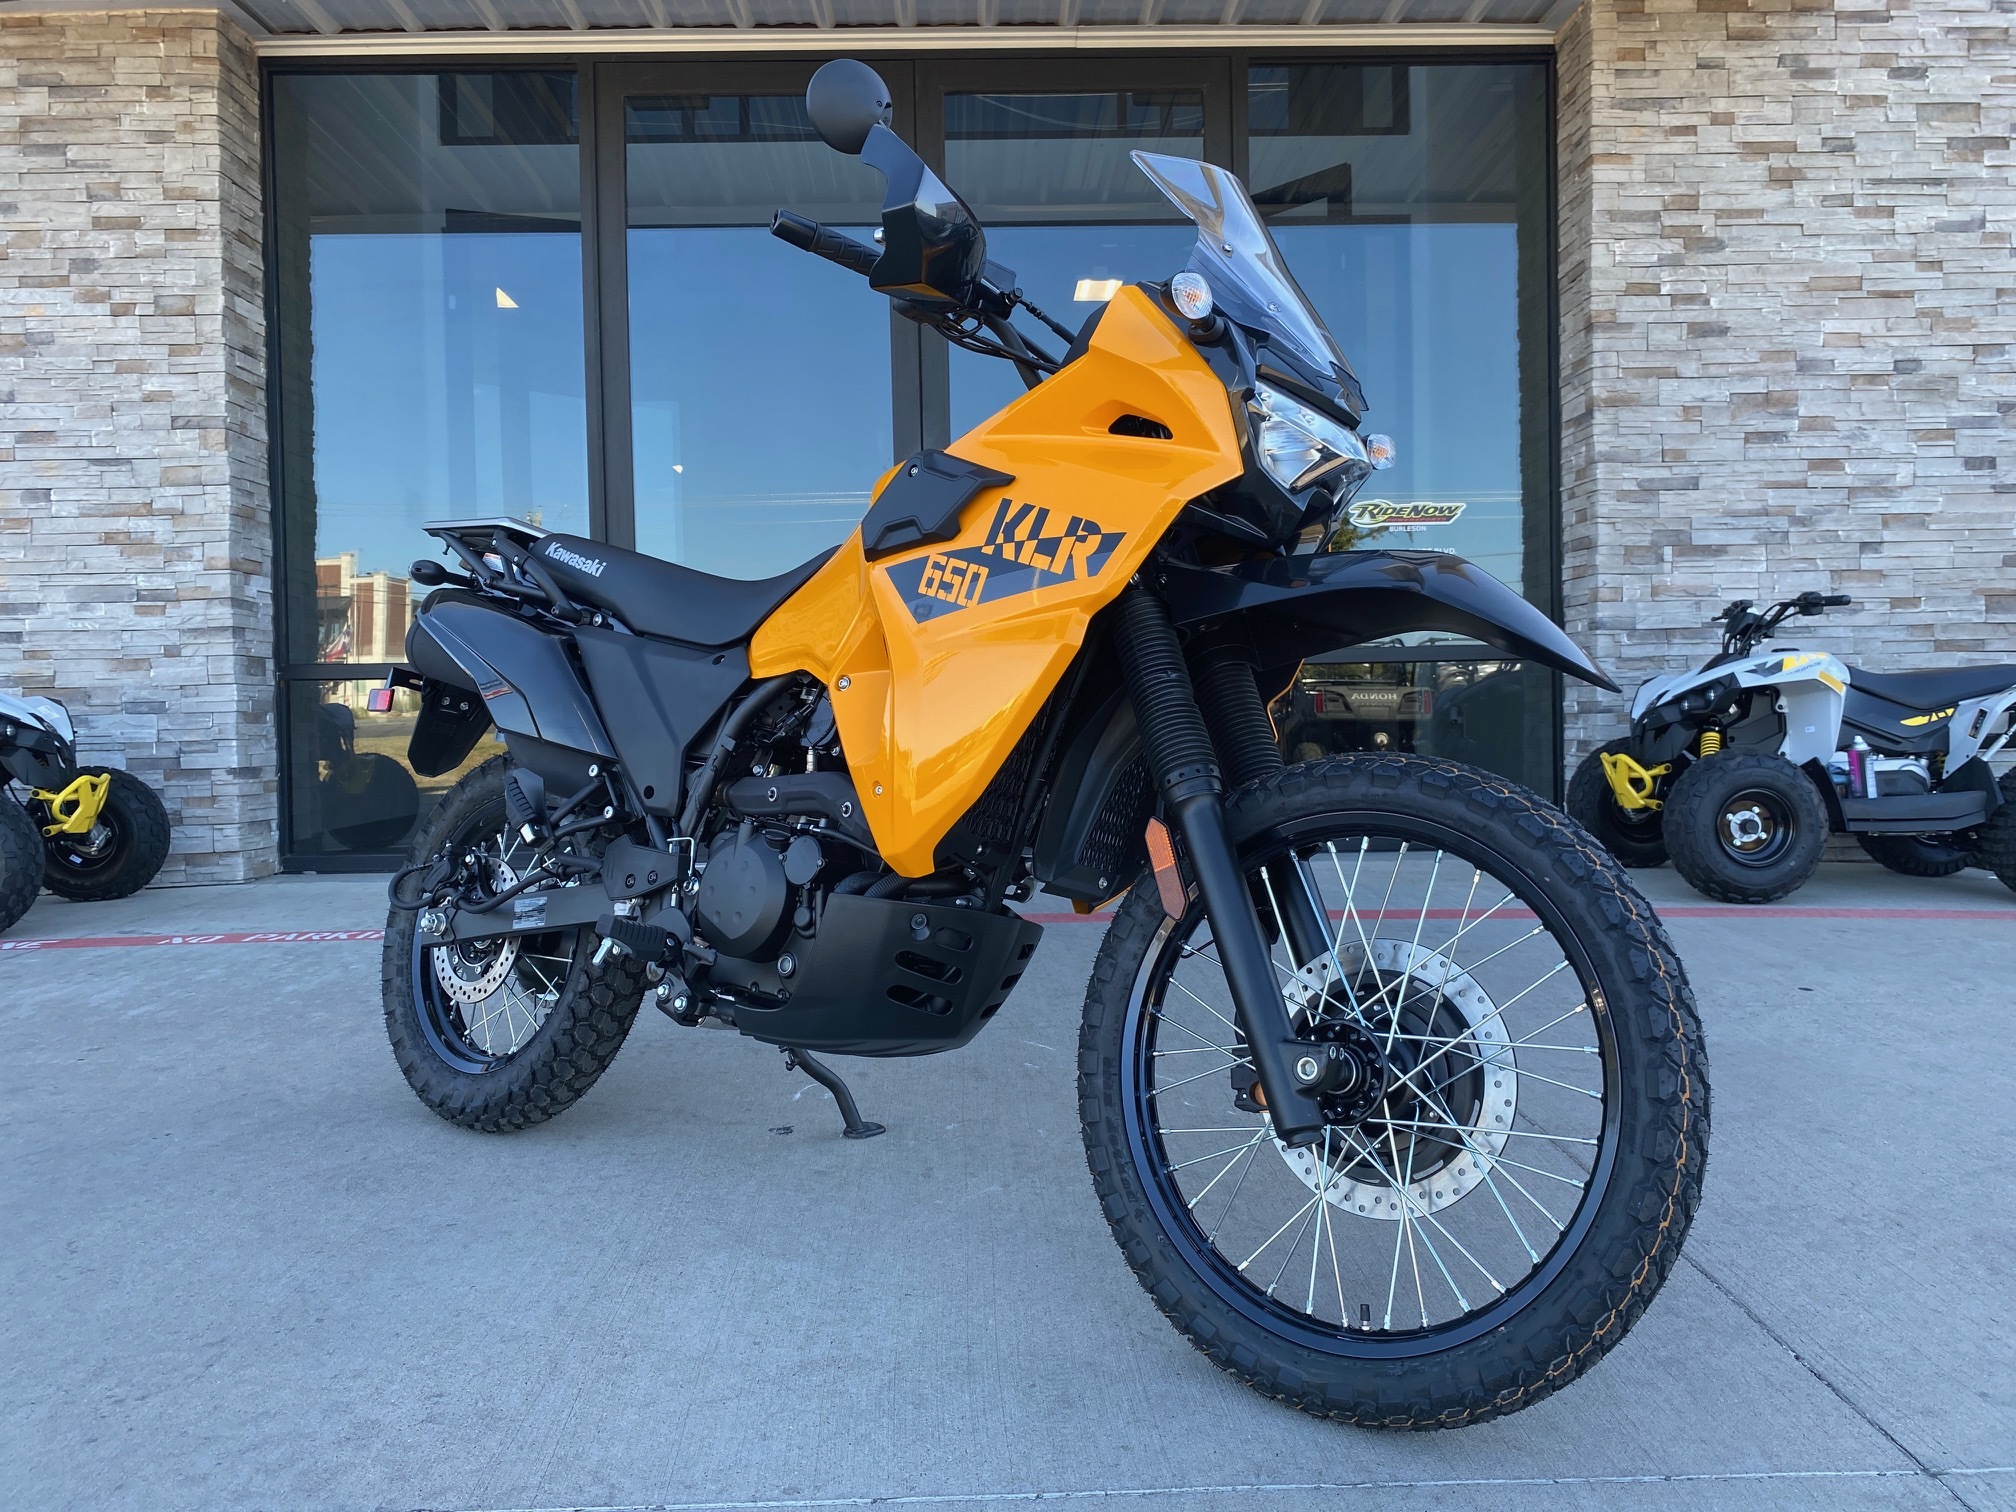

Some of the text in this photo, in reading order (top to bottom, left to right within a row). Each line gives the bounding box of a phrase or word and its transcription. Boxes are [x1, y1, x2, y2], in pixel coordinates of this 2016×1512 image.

[544, 541, 607, 578] Kawasaki
[981, 498, 1102, 580] KLR
[918, 553, 989, 606] 650
[156, 935, 225, 945] NO
[242, 931, 385, 942] PARKI
